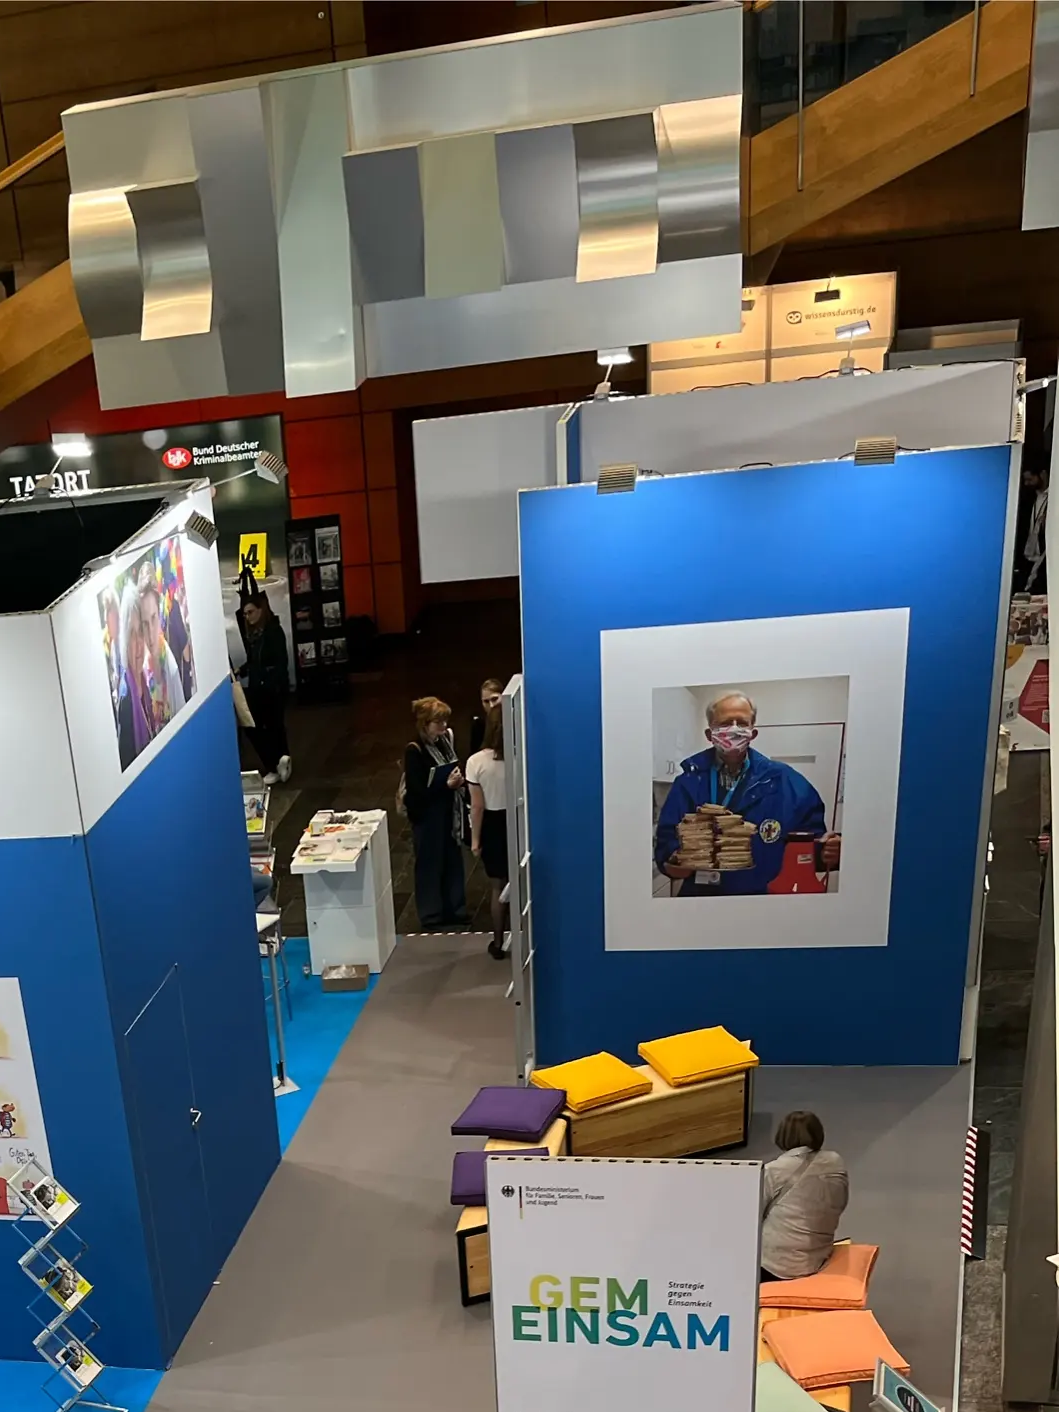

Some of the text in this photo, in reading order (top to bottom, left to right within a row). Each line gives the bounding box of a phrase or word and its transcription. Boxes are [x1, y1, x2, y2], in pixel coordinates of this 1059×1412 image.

[805, 305, 877, 320] wissensdurstig.de
[192, 441, 259, 456] Bund Deutscher
[245, 544, 259, 567] 4
[668, 1281, 705, 1291] Strategie
[529, 1274, 648, 1315] GEM
[667, 1290, 692, 1298] gegen
[668, 1299, 713, 1308] Einsamkeit
[512, 1305, 730, 1352] EINSAM
